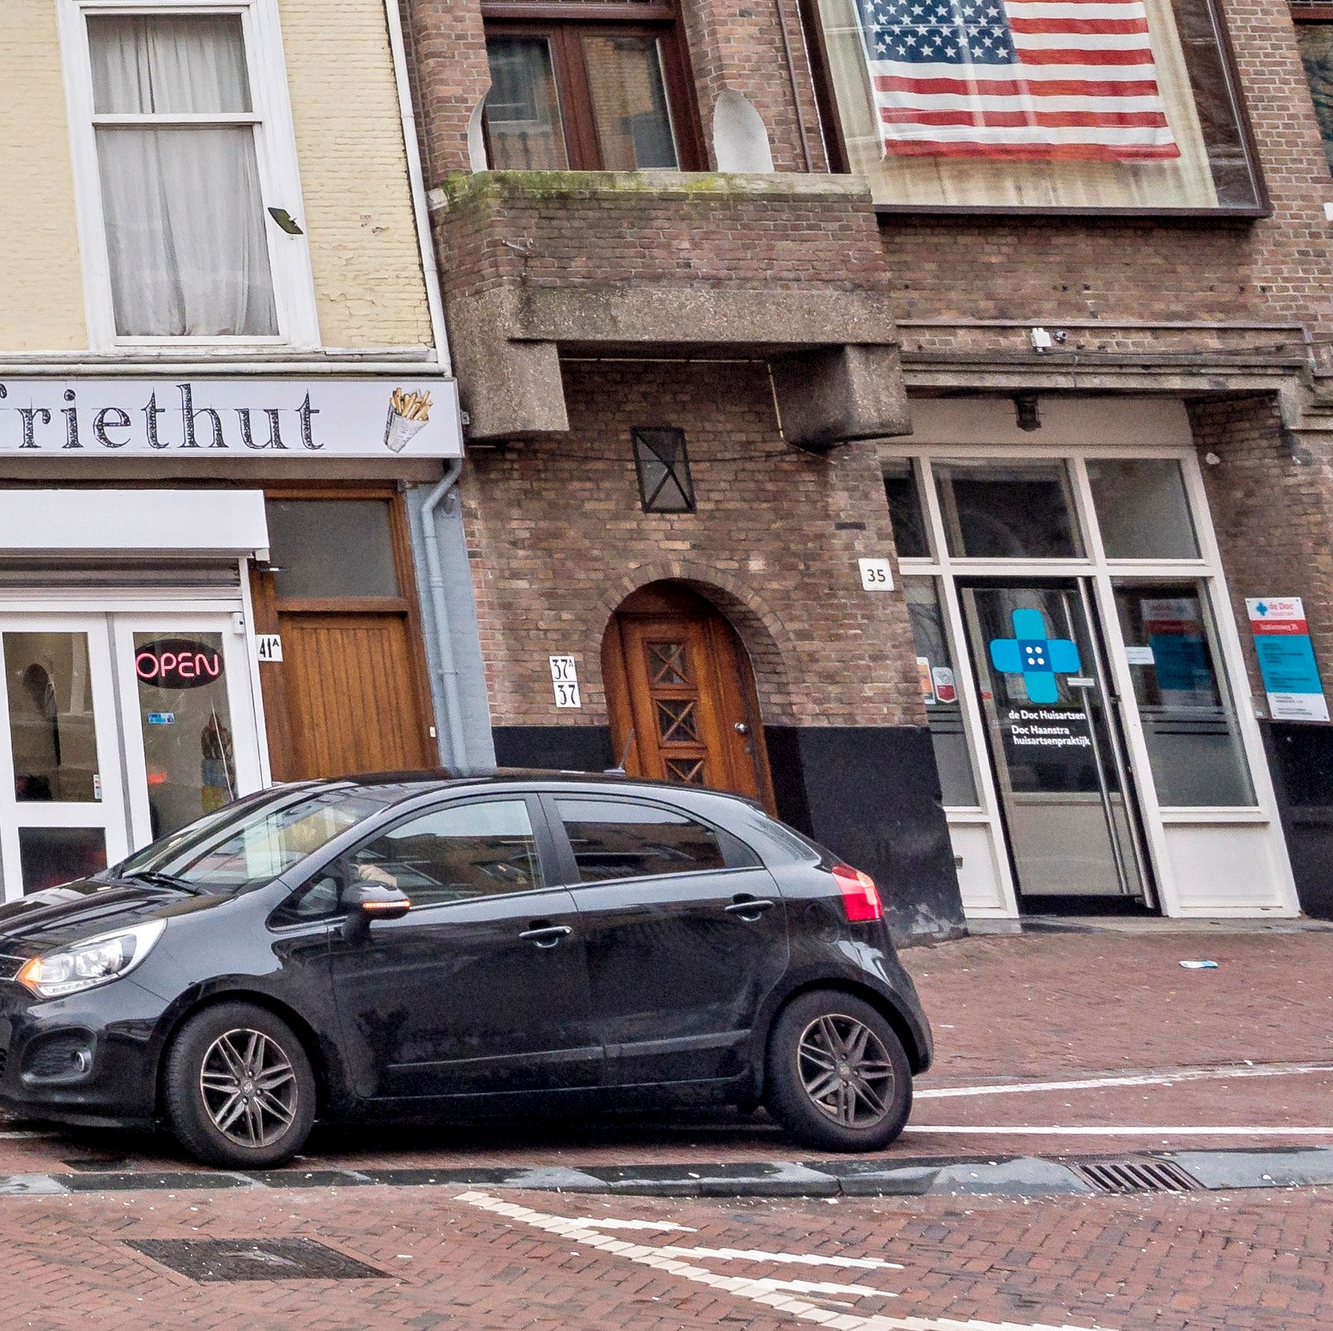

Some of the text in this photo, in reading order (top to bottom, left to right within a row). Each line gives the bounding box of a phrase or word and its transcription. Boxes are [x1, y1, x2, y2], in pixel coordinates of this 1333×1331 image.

[867, 569, 886, 582] 35
[259, 638, 279, 658] 41A
[136, 652, 219, 678] OPEN
[552, 659, 574, 679] 37A
[558, 685, 576, 705] 37
[1008, 710, 1086, 720] de Doc Huisartsen
[1011, 725, 1070, 735] Doc Haanstra
[1013, 735, 1091, 747] huisartsenpraktijk
